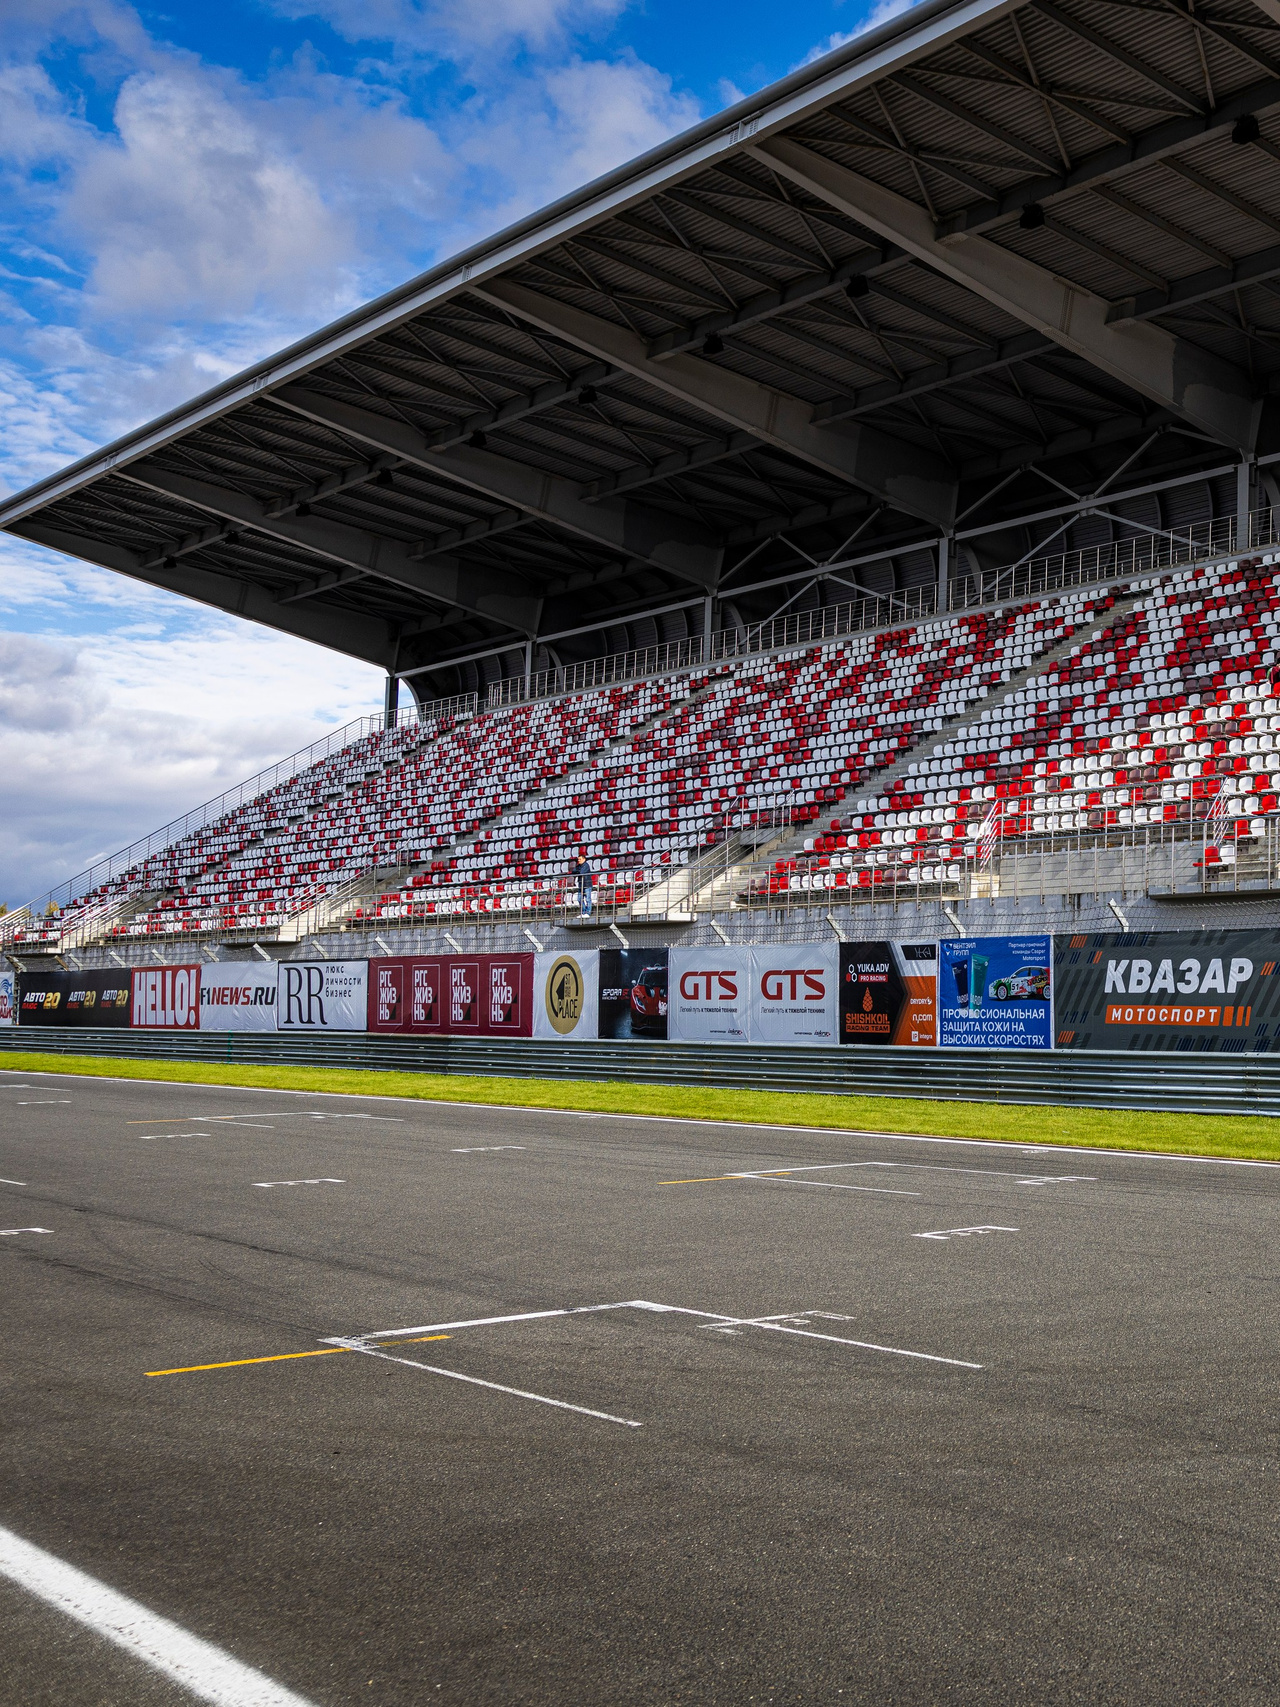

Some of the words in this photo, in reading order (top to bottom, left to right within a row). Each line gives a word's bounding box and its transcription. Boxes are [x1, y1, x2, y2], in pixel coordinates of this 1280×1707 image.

[326, 966, 344, 974] люкс
[857, 964, 874, 972] YUKA
[875, 964, 890, 972] ADV
[1104, 958, 1254, 994] КВАЗАР
[326, 977, 362, 986] личности
[380, 971, 392, 986] РГС
[414, 970, 428, 986] РГС
[452, 968, 466, 986] РГС
[492, 968, 507, 986] РГС
[680, 970, 738, 1000] GTS
[760, 970, 826, 1000] GTS
[24, 992, 46, 1002] АВТО
[43, 992, 61, 1009] 20
[68, 991, 85, 1002] АВТО
[83, 991, 96, 1008] 20
[101, 990, 118, 1000] АВТО
[115, 990, 128, 1007] 20
[133, 969, 196, 1026] HELLO!
[200, 987, 276, 1005] F1NEWS.RU
[284, 966, 328, 1025] RR
[326, 986, 352, 998] бизнес
[380, 988, 396, 1004] ЖИЗ
[414, 987, 432, 1004] ЖИЗ
[452, 987, 472, 1004] ЖИЗ
[492, 986, 512, 1004] ЖИЗ
[380, 1004, 390, 1020] НЬ
[414, 1004, 425, 1020] НЬ
[452, 1004, 464, 1021] НЬ
[492, 1004, 504, 1022] НЬ
[846, 1013, 890, 1024] SHISHKOIL
[942, 1008, 1045, 1019] ПРОФЕССИОНАЛЬНАЯ
[1111, 1007, 1218, 1023] МОТОСПОРТ
[942, 1022, 980, 1033] ЗАЩИТА
[982, 1022, 1011, 1032] КОЖИ
[1012, 1022, 1025, 1032] НА
[942, 1034, 986, 1045] ВЫСОКИХ
[988, 1035, 1045, 1045] СКОРОСТЯХ
